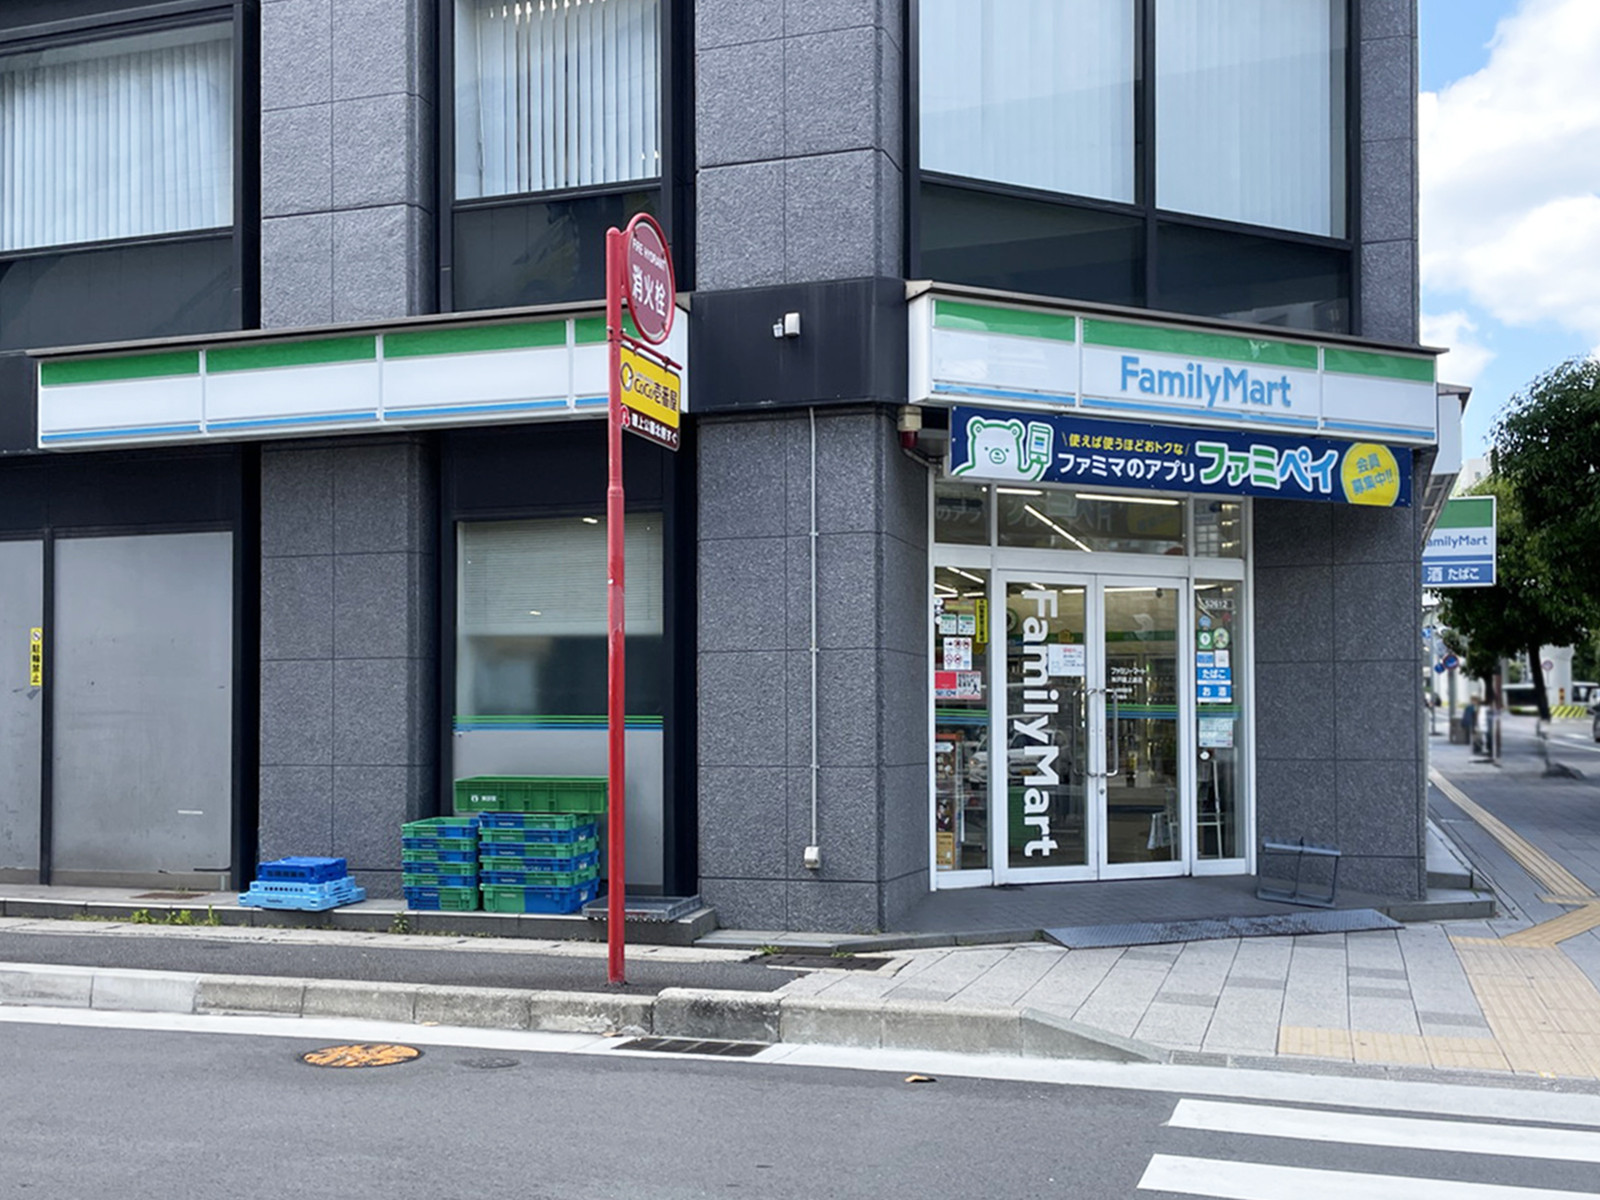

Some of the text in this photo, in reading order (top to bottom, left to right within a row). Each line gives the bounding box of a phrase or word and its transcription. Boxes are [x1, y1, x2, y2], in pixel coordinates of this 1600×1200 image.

[632, 264, 666, 317] 消火栓
[1120, 355, 1292, 408] FamilyMart
[1068, 433, 1184, 456] 使えば使うほどおトクな
[1057, 453, 1196, 483] ファミマのアプリ
[1195, 441, 1339, 494] ファミペイ
[1356, 452, 1382, 474] 会員
[1426, 535, 1488, 549] amilyMart
[1427, 566, 1480, 582] 酒 たばこ
[1202, 669, 1227, 680] たばこ
[1013, 589, 1060, 858] FamilyMart
